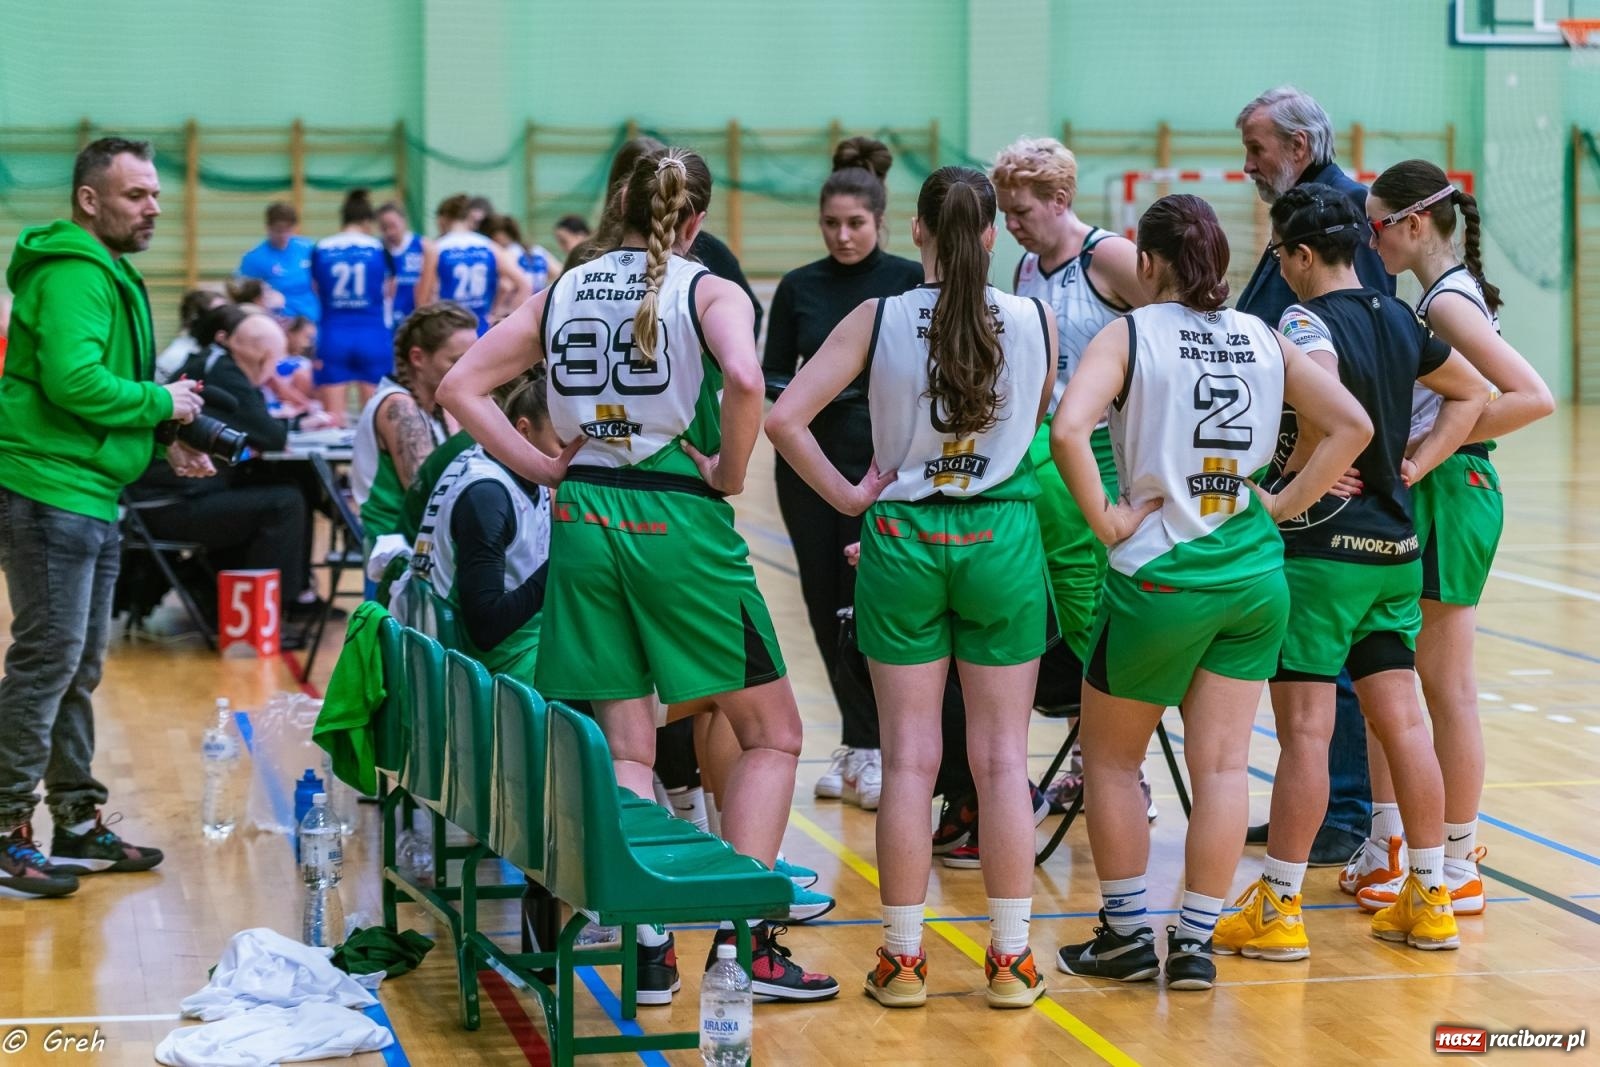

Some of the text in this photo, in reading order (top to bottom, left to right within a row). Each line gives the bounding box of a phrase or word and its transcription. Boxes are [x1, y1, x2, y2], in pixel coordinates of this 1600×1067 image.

[331, 262, 366, 298] 21
[453, 262, 488, 299] 26
[575, 287, 647, 302] RACIBÓR
[582, 272, 648, 285] RKK AZ
[1179, 329, 1215, 345] RKK
[551, 317, 671, 397] 33
[1193, 372, 1253, 451] 2
[928, 457, 985, 475] SEGET
[1192, 476, 1240, 493] SEGE
[226, 581, 253, 638] 5
[261, 580, 279, 638] 5
